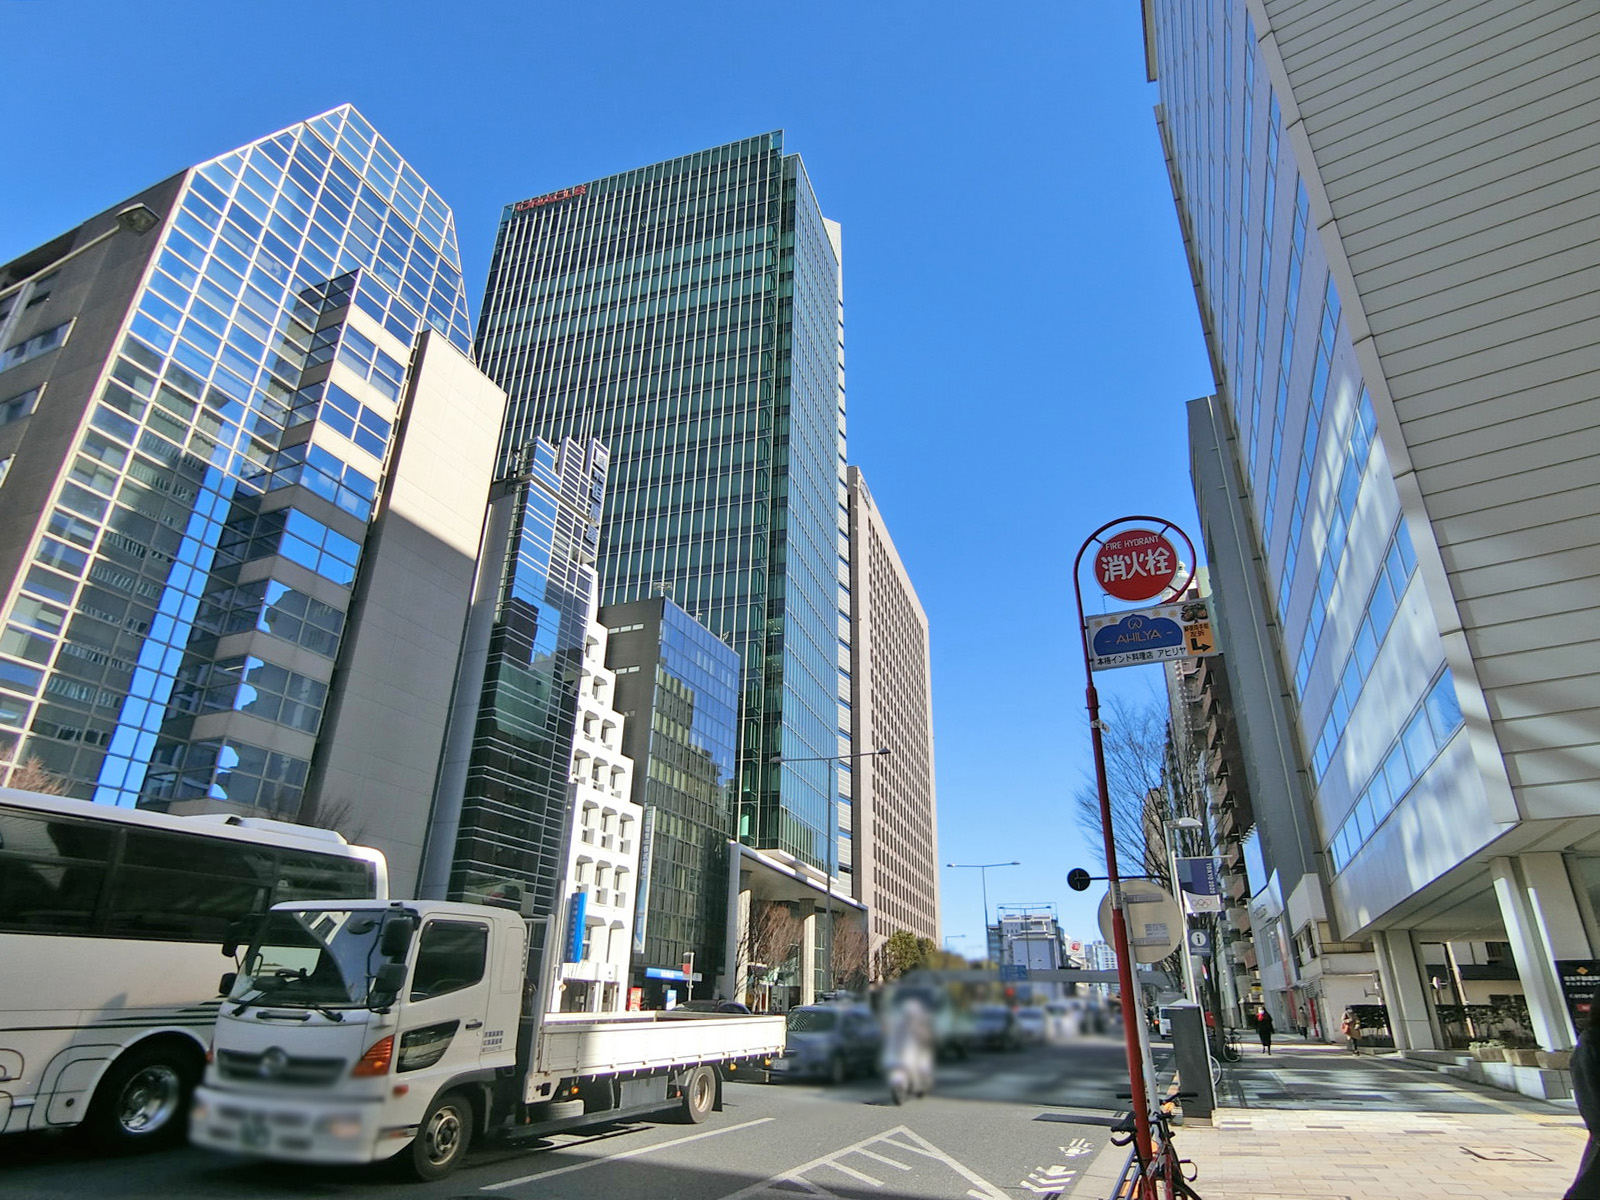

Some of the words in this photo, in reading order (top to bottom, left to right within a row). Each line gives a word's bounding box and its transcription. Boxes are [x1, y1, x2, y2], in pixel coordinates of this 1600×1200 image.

[516, 185, 586, 211] ORACLE
[1105, 540, 1122, 551] FIRE
[1124, 535, 1159, 548] HYDRANT
[1101, 547, 1172, 583] 消火栓
[1116, 629, 1161, 645] AHILYA
[1097, 650, 1154, 666] 本格インド料理店
[1157, 646, 1187, 658] アヒリヤ
[1206, 862, 1214, 880] TOKYO
[1208, 881, 1216, 895] 2020
